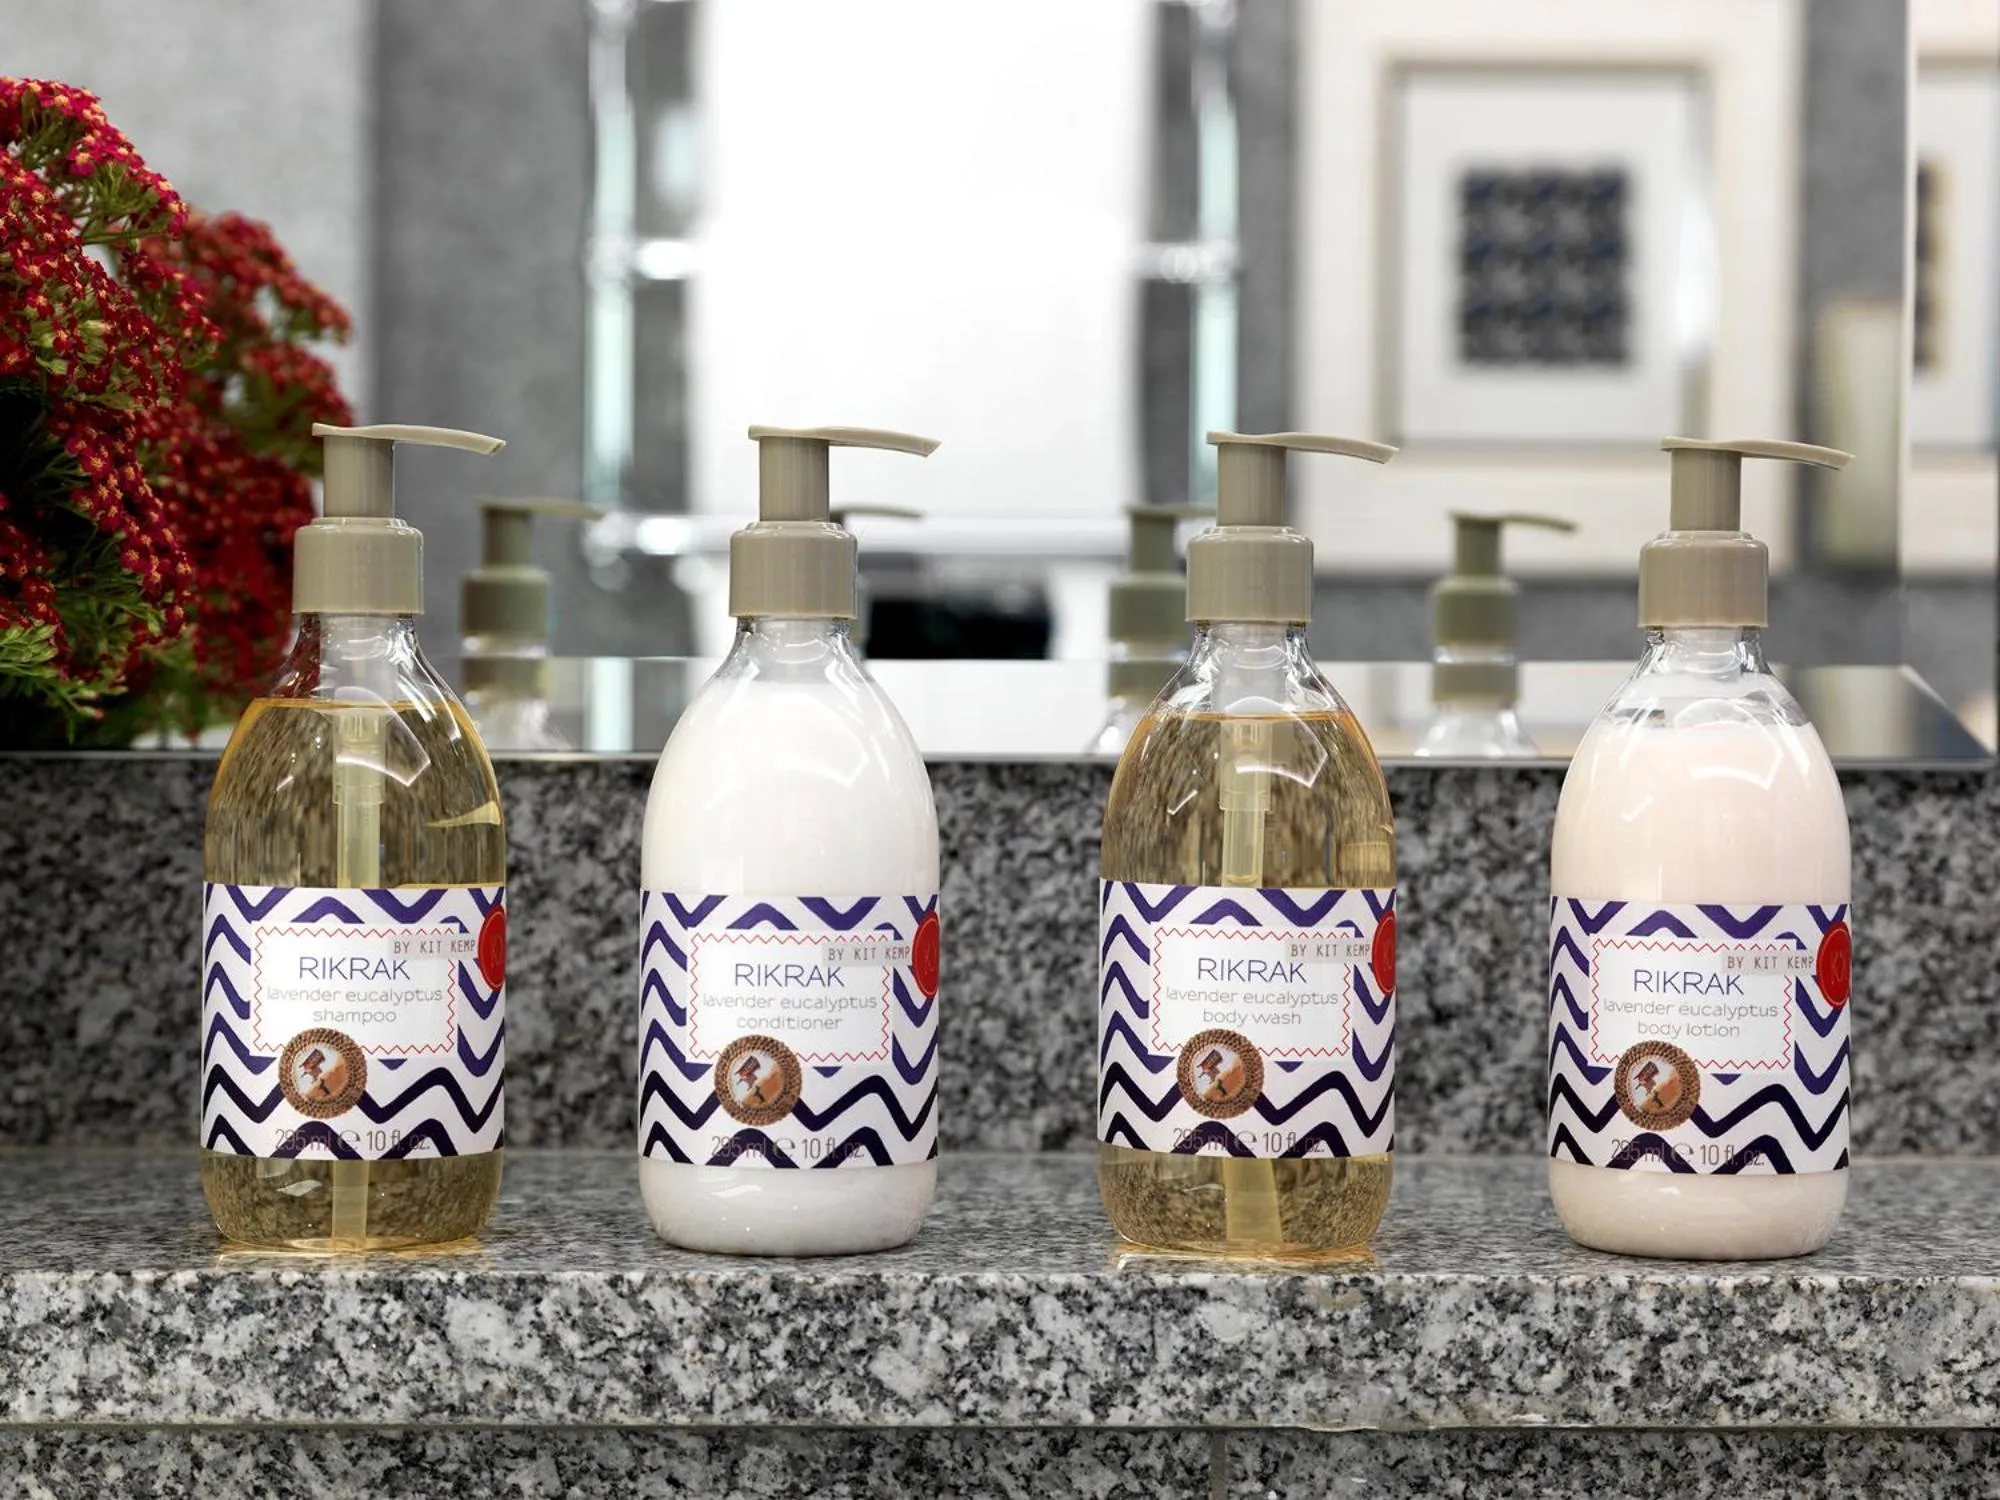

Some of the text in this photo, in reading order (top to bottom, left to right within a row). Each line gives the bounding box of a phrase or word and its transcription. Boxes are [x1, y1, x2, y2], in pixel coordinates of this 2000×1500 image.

[394, 940, 476, 954] BY KIT KEMP
[828, 946, 910, 961] BY KIT KEMP
[1291, 943, 1370, 957] BY KIT KEMP
[299, 956, 411, 980] RIKRAK
[1197, 957, 1307, 984] RIKRAK
[1727, 955, 1815, 969] BY KIT KEMP
[735, 963, 845, 988] RIKRAK
[1633, 969, 1744, 995] RIKRAK
[267, 985, 443, 1006] lavender eucalyptus
[703, 992, 877, 1013] lavender eucalyptus
[1166, 986, 1338, 1008] lavender eucalyptus
[313, 1008, 397, 1025] shampoo
[1203, 1009, 1302, 1028] body wash
[1603, 998, 1778, 1020] lavender eucalyptus
[736, 1016, 843, 1030] conditioner
[1638, 1020, 1740, 1038] body lotion
[310, 1130, 332, 1151] ml
[367, 1130, 386, 1151] 10
[746, 1137, 766, 1159] ml
[802, 1138, 821, 1159] 10
[1208, 1129, 1228, 1151] ml
[1263, 1132, 1282, 1153] 10
[1645, 1141, 1665, 1163] ml
[1700, 1145, 1719, 1165] 10
